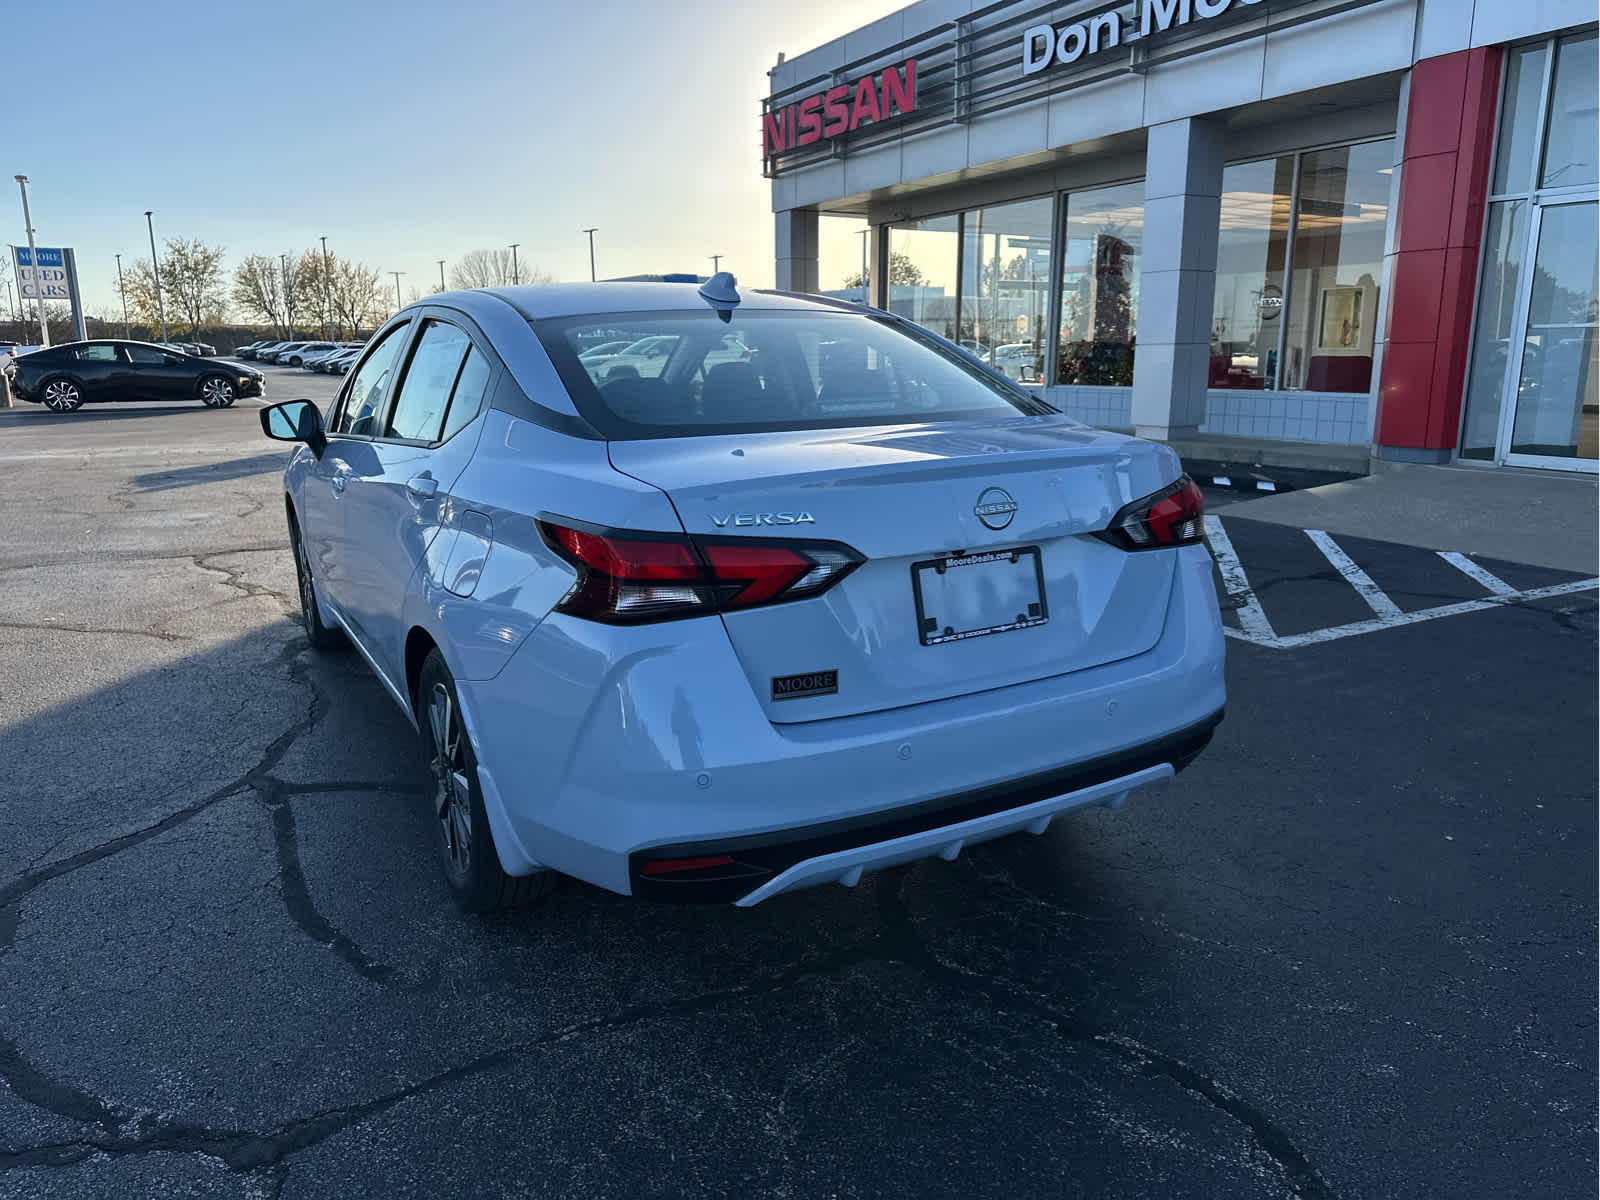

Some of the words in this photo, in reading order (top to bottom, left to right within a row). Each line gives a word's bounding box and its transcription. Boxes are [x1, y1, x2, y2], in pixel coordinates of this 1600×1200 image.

[1023, 11, 1120, 75] Don
[763, 59, 917, 156] NISSAN
[19, 252, 60, 261] MORE
[975, 503, 1017, 515] NISSAN
[707, 512, 816, 527] VERSA
[946, 552, 1012, 567] MooreDeals.com
[777, 674, 833, 692] MOORE
